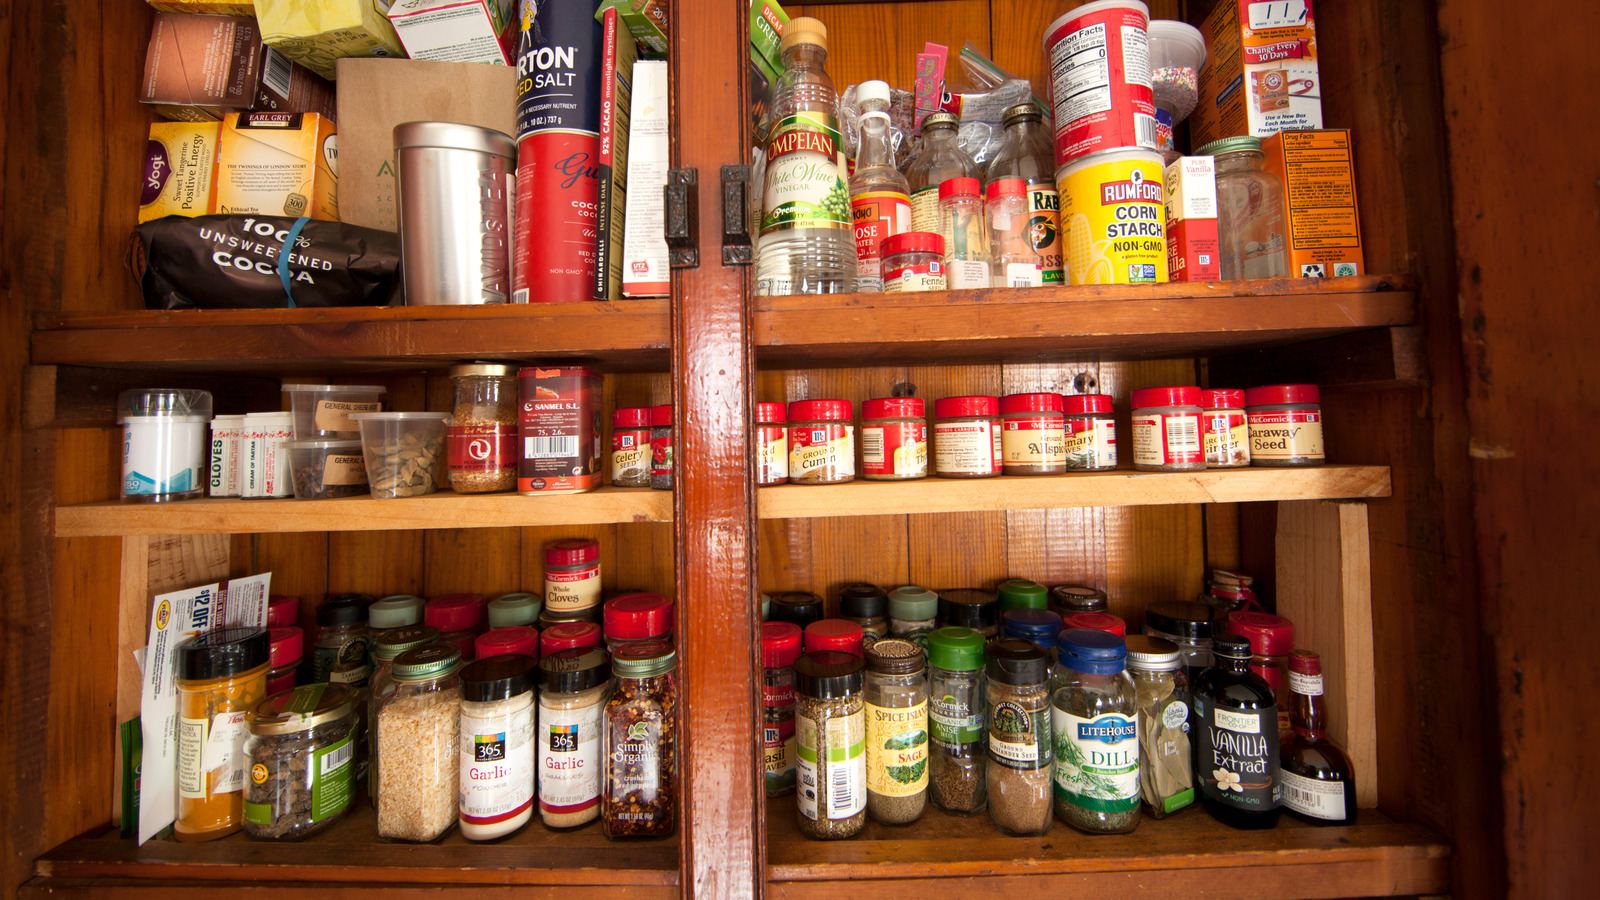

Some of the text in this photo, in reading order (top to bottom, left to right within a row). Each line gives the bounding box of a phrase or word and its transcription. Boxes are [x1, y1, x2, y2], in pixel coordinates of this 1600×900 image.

[1078, 25, 1104, 38] Facts
[1099, 48, 1106, 57] 0
[1246, 46, 1275, 56] Change
[1259, 51, 1289, 62] 30 Days
[535, 72, 576, 89] SALT
[605, 58, 614, 98] moonlight
[173, 142, 188, 202] Sweet Tangerine
[182, 133, 204, 210] Positive Energy
[792, 162, 834, 183] Wine
[776, 184, 810, 194] VINEGAR
[1105, 184, 1162, 202] RUMFORD
[288, 199, 303, 208] 300
[773, 204, 811, 218] Premium
[1116, 206, 1157, 220] CORN
[1107, 223, 1162, 238] STARCH
[200, 228, 333, 272] UNSWEEENED
[1114, 241, 1162, 252] NON-GMO
[921, 277, 945, 285] Fennel
[324, 402, 352, 410] GENERAL
[1248, 427, 1301, 439] Caraway
[1255, 438, 1287, 450] Seed
[211, 439, 223, 488] CLOVES
[616, 450, 643, 464] Celery
[620, 460, 637, 469] SEED
[548, 593, 579, 603] Cloves
[192, 589, 210, 628] $12 OFF
[875, 710, 905, 722] SPICE
[934, 714, 964, 726] ORGANIC
[1217, 713, 1257, 725] FRONTIER
[936, 724, 958, 735] ANISE
[1081, 726, 1134, 736] LITEHOUSE
[553, 734, 574, 748] 365
[617, 740, 656, 753] Simply
[1000, 743, 1023, 752] GROUND
[1208, 726, 1268, 757] VANILLA
[478, 743, 501, 758] 365
[898, 750, 922, 764] SAGE
[546, 757, 584, 770] Garlic
[1091, 750, 1131, 766] DILL
[1213, 750, 1268, 774] Extract
[469, 766, 512, 780] Garlic
[1057, 768, 1082, 783] Fresh
